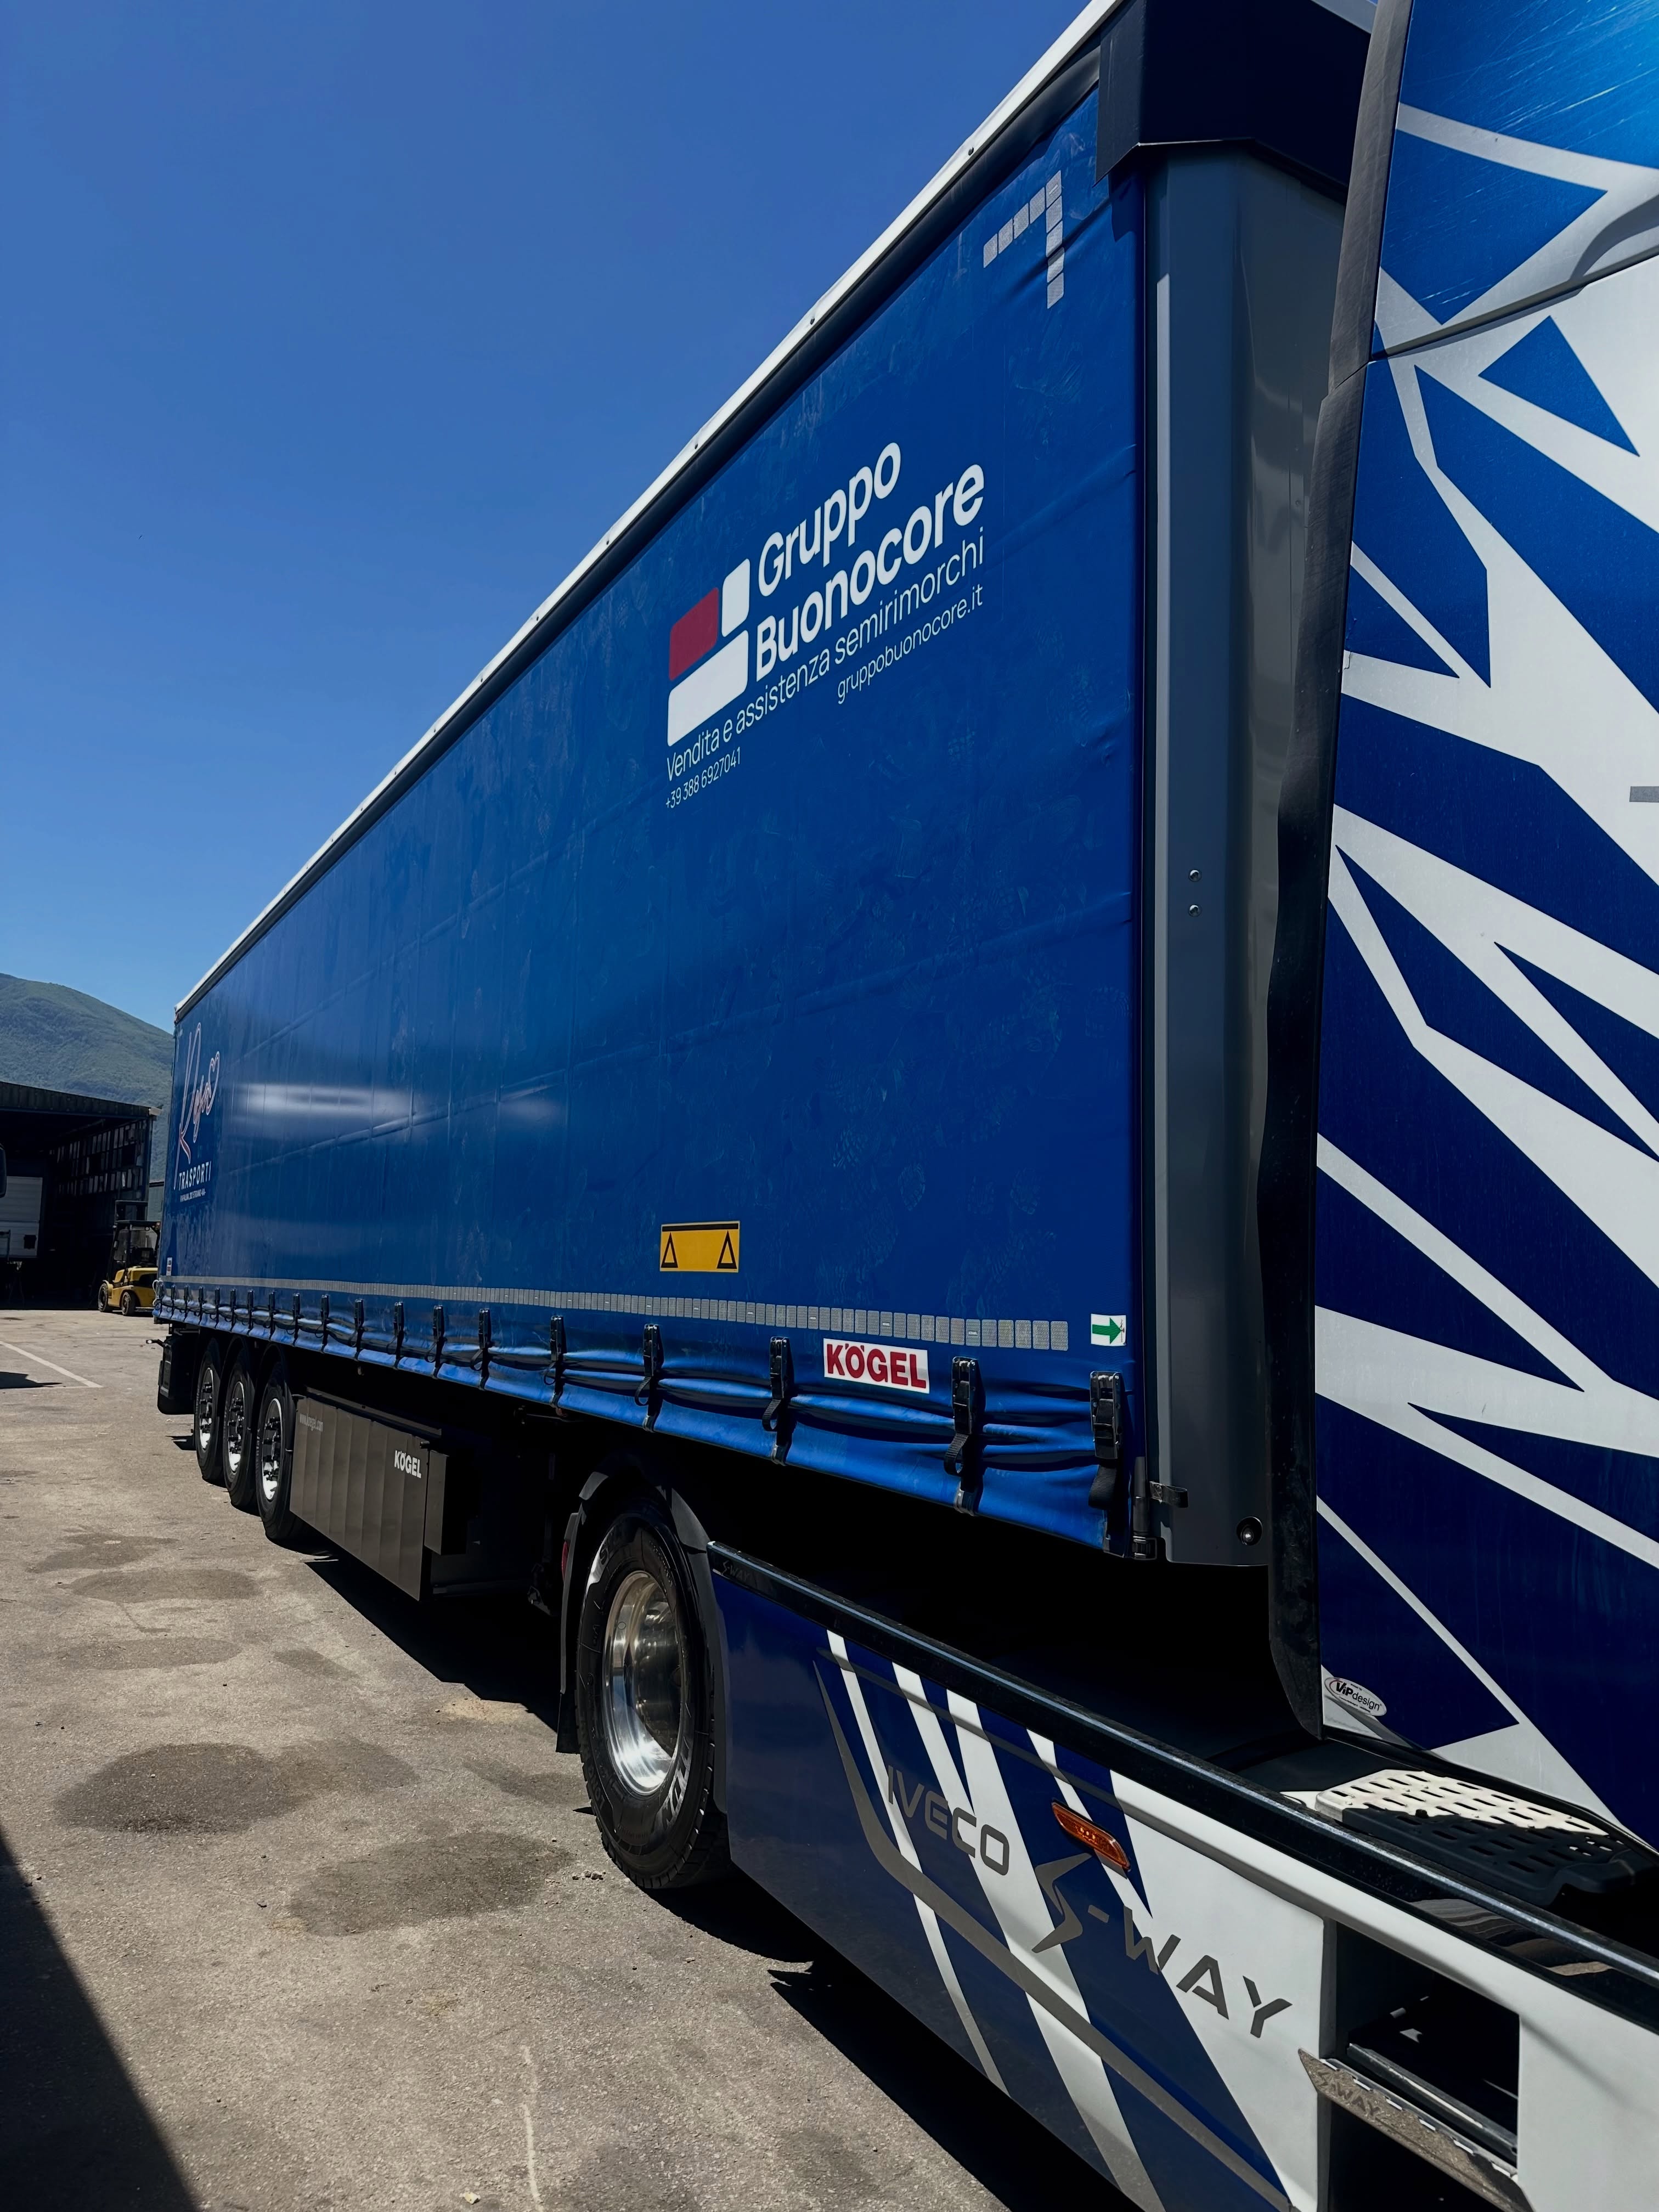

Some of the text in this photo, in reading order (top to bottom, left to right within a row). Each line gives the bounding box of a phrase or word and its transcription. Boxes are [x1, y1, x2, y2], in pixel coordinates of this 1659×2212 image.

[756, 464, 984, 681] Buonocore
[758, 442, 901, 597] Gruppo
[667, 526, 984, 781] Vendita e assistenza semirimorchi
[837, 584, 983, 704] gruppobuonocore.it
[665, 746, 741, 809] +39 388 6927041
[178, 1161, 212, 1191] TRASPORTI
[827, 1344, 927, 1389] KÖGEL
[394, 1449, 422, 1479] KÖGEL
[888, 1764, 1009, 1876] IVECO
